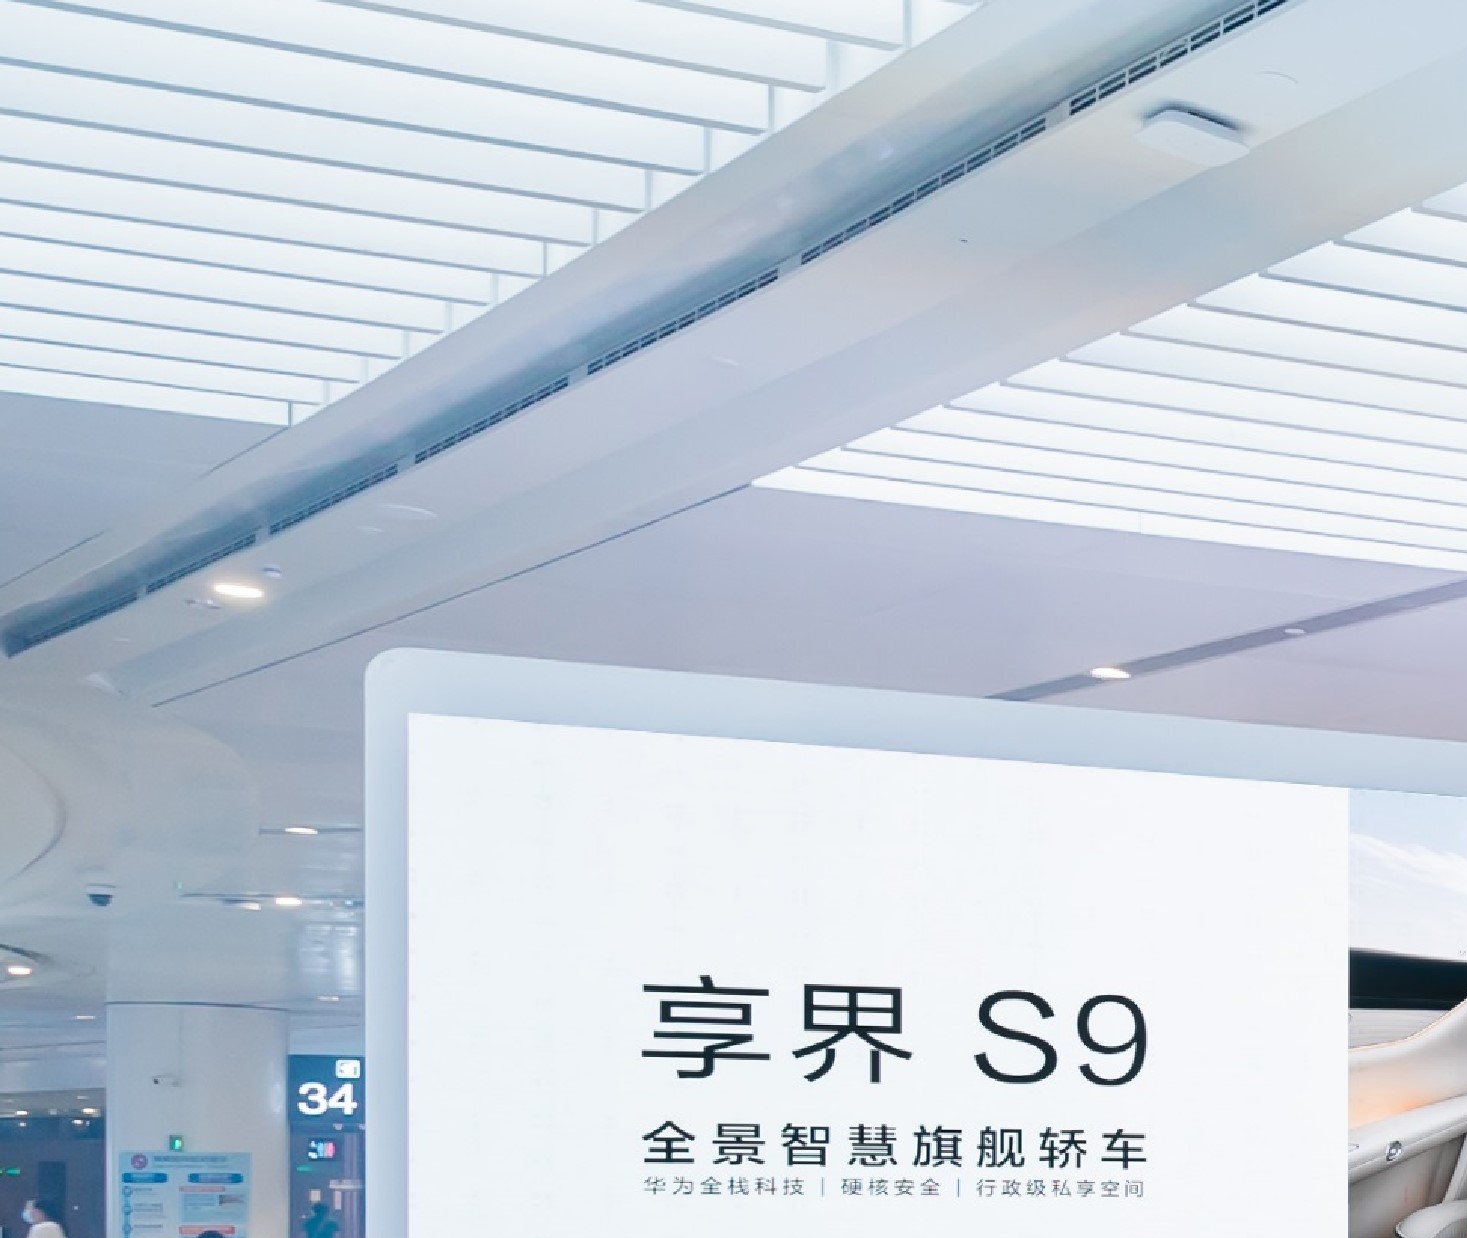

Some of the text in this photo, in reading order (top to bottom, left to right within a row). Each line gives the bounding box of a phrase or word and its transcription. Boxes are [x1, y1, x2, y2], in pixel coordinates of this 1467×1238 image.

[642, 975, 1148, 1087] 享界 S9
[297, 1081, 358, 1115] 34
[641, 1120, 1147, 1169] 全景智慧旗舰轿车
[643, 1176, 1145, 1199] 华为全栈科技 硬核安全 行政级私享空间
